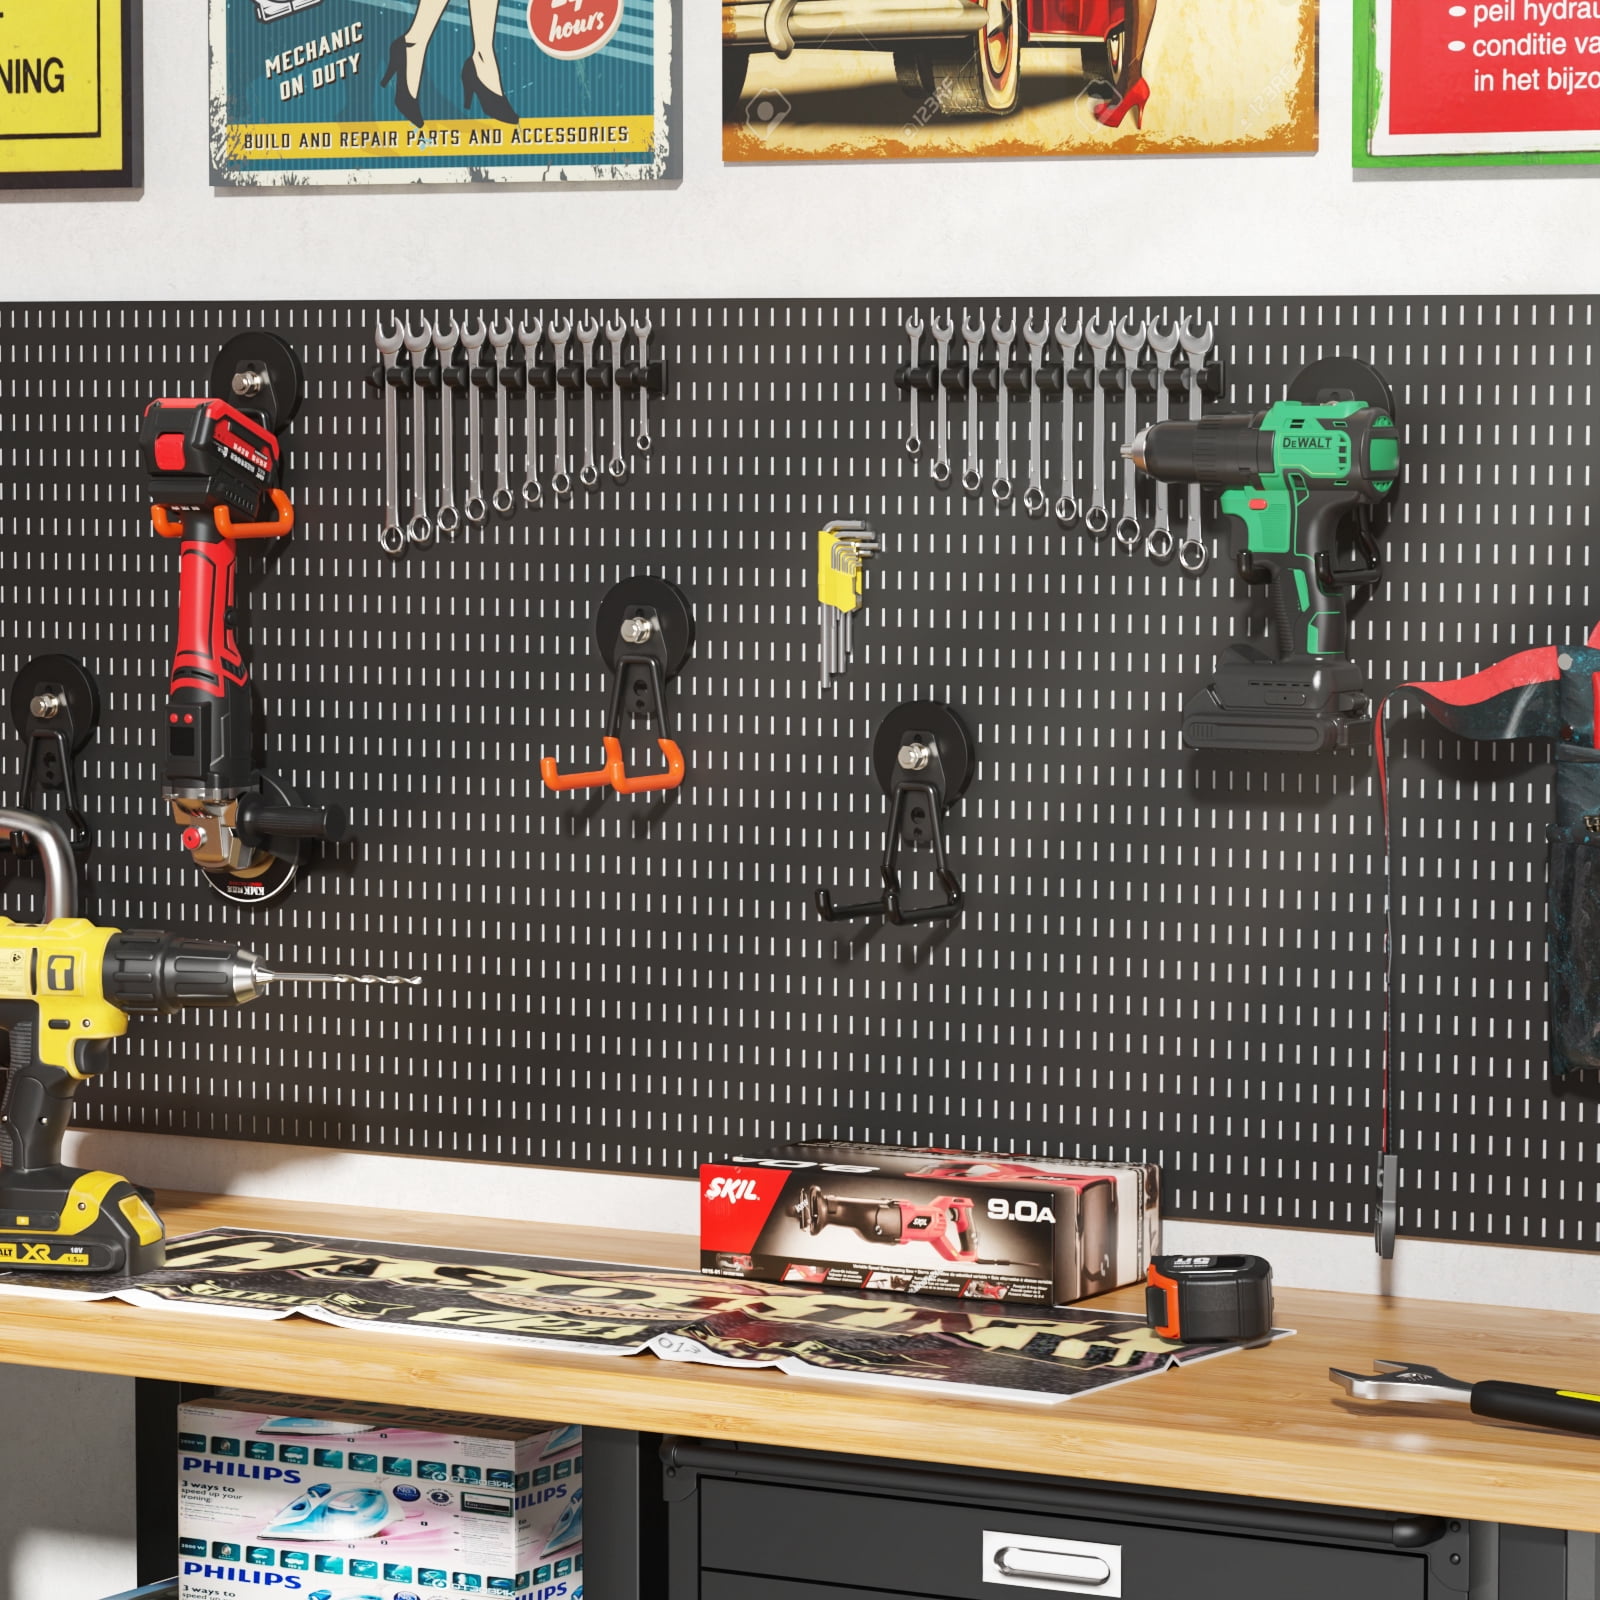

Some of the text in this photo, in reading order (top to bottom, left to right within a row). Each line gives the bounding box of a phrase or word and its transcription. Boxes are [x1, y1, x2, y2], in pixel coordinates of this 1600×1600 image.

[549, 11, 604, 42] hours
[1474, 0, 1515, 28] peil
[265, 21, 363, 78] MECHANIC
[1473, 32, 1567, 57] conditie
[280, 52, 361, 101] ON DUTY
[1474, 69, 1494, 92] in
[1503, 68, 1540, 91] het
[244, 126, 629, 149] BUILD AND REPAIR PARTS AND ACCESSORIES
[705, 1177, 757, 1203] SKIL
[987, 1198, 1056, 1224] 9.0A
[22, 1243, 52, 1260] XR
[182, 1456, 301, 1484] PHILIPS
[191, 1481, 219, 1491] ways
[222, 1485, 235, 1493] to
[184, 1561, 302, 1590] PHILIPS
[192, 1586, 220, 1596] ways
